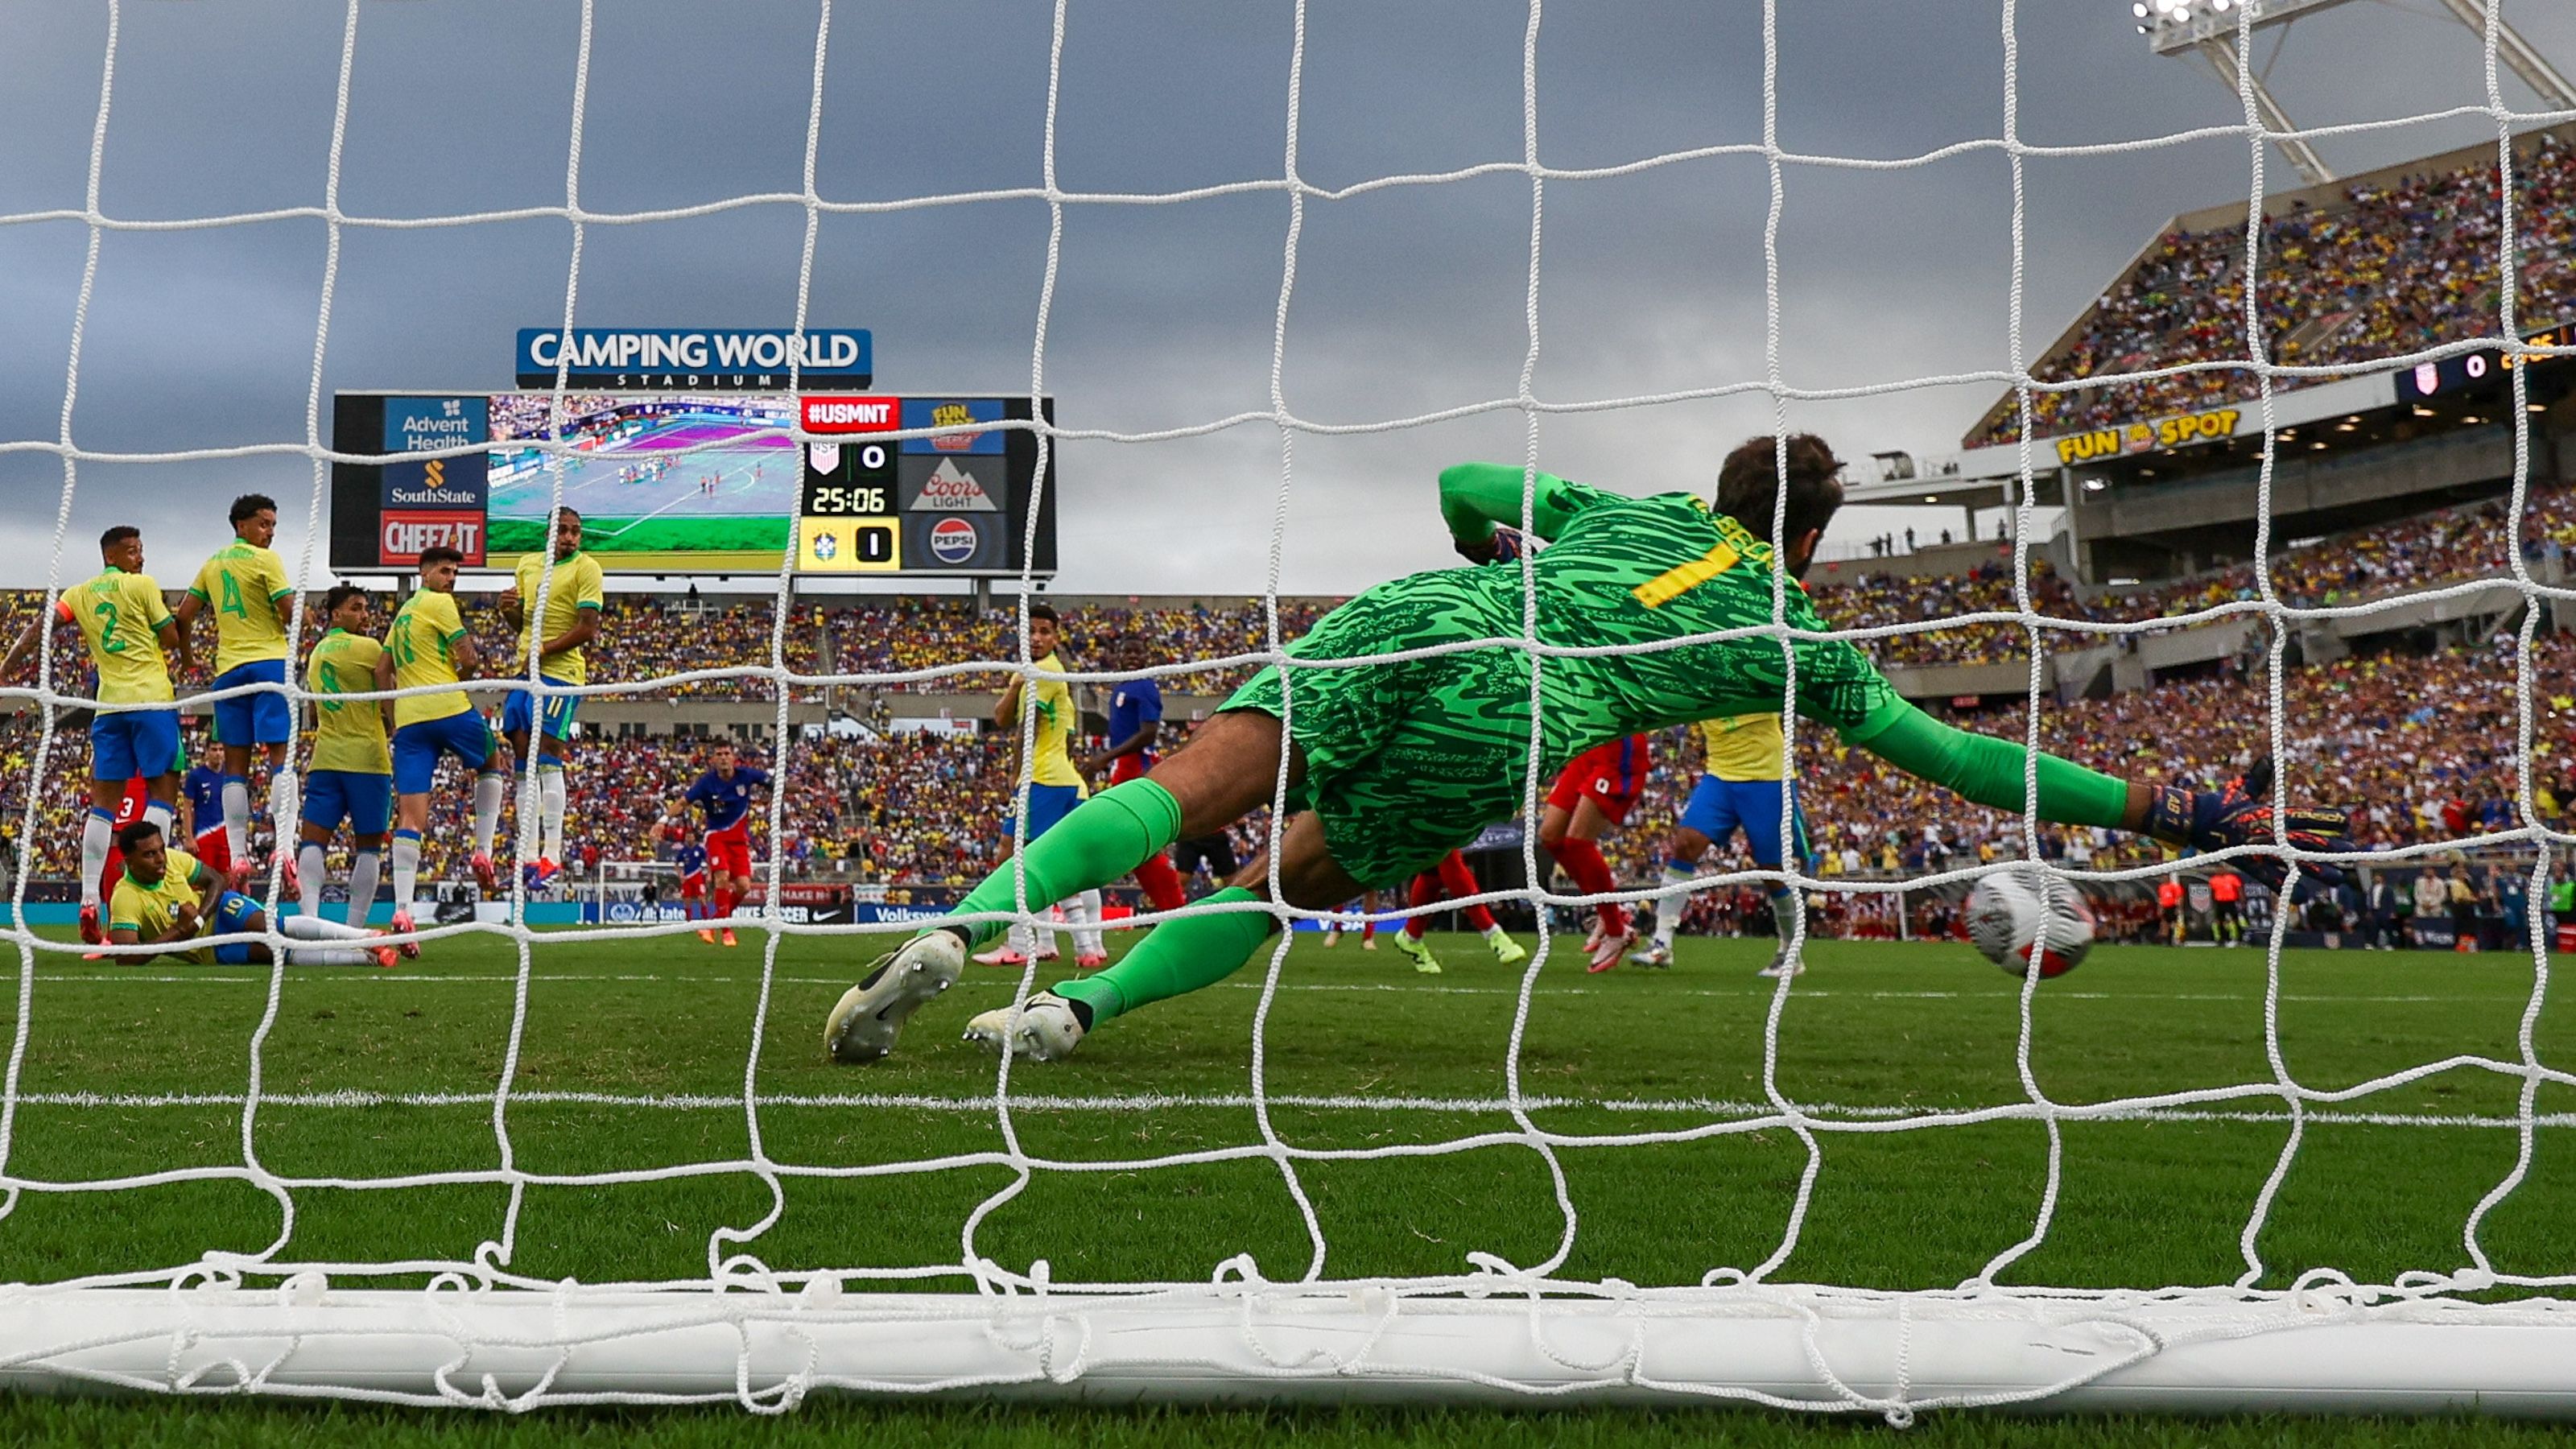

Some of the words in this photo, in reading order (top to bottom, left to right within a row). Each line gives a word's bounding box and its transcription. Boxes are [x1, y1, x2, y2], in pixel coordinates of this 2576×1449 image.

[530, 333, 708, 368] CAMPING
[714, 333, 859, 368] WORLD
[617, 374, 771, 386] STADIUM
[402, 415, 469, 433] Advent
[807, 403, 890, 423] #USMNT
[407, 435, 469, 451] Health
[2057, 430, 2120, 464] FUN
[2159, 409, 2240, 445] SPOT
[862, 445, 886, 469] 0
[391, 488, 476, 504] SouthState
[923, 473, 985, 497] Coors
[812, 488, 886, 513] 25:06
[932, 497, 972, 508] LIGHT
[869, 532, 879, 556] 1
[934, 535, 973, 546] PEPSI
[1632, 542, 1740, 609] 1
[220, 569, 248, 619] 4
[94, 601, 126, 654] 2
[320, 660, 344, 712] 8
[547, 695, 564, 718] 11
[120, 797, 134, 818] 3
[223, 898, 246, 917] 10
